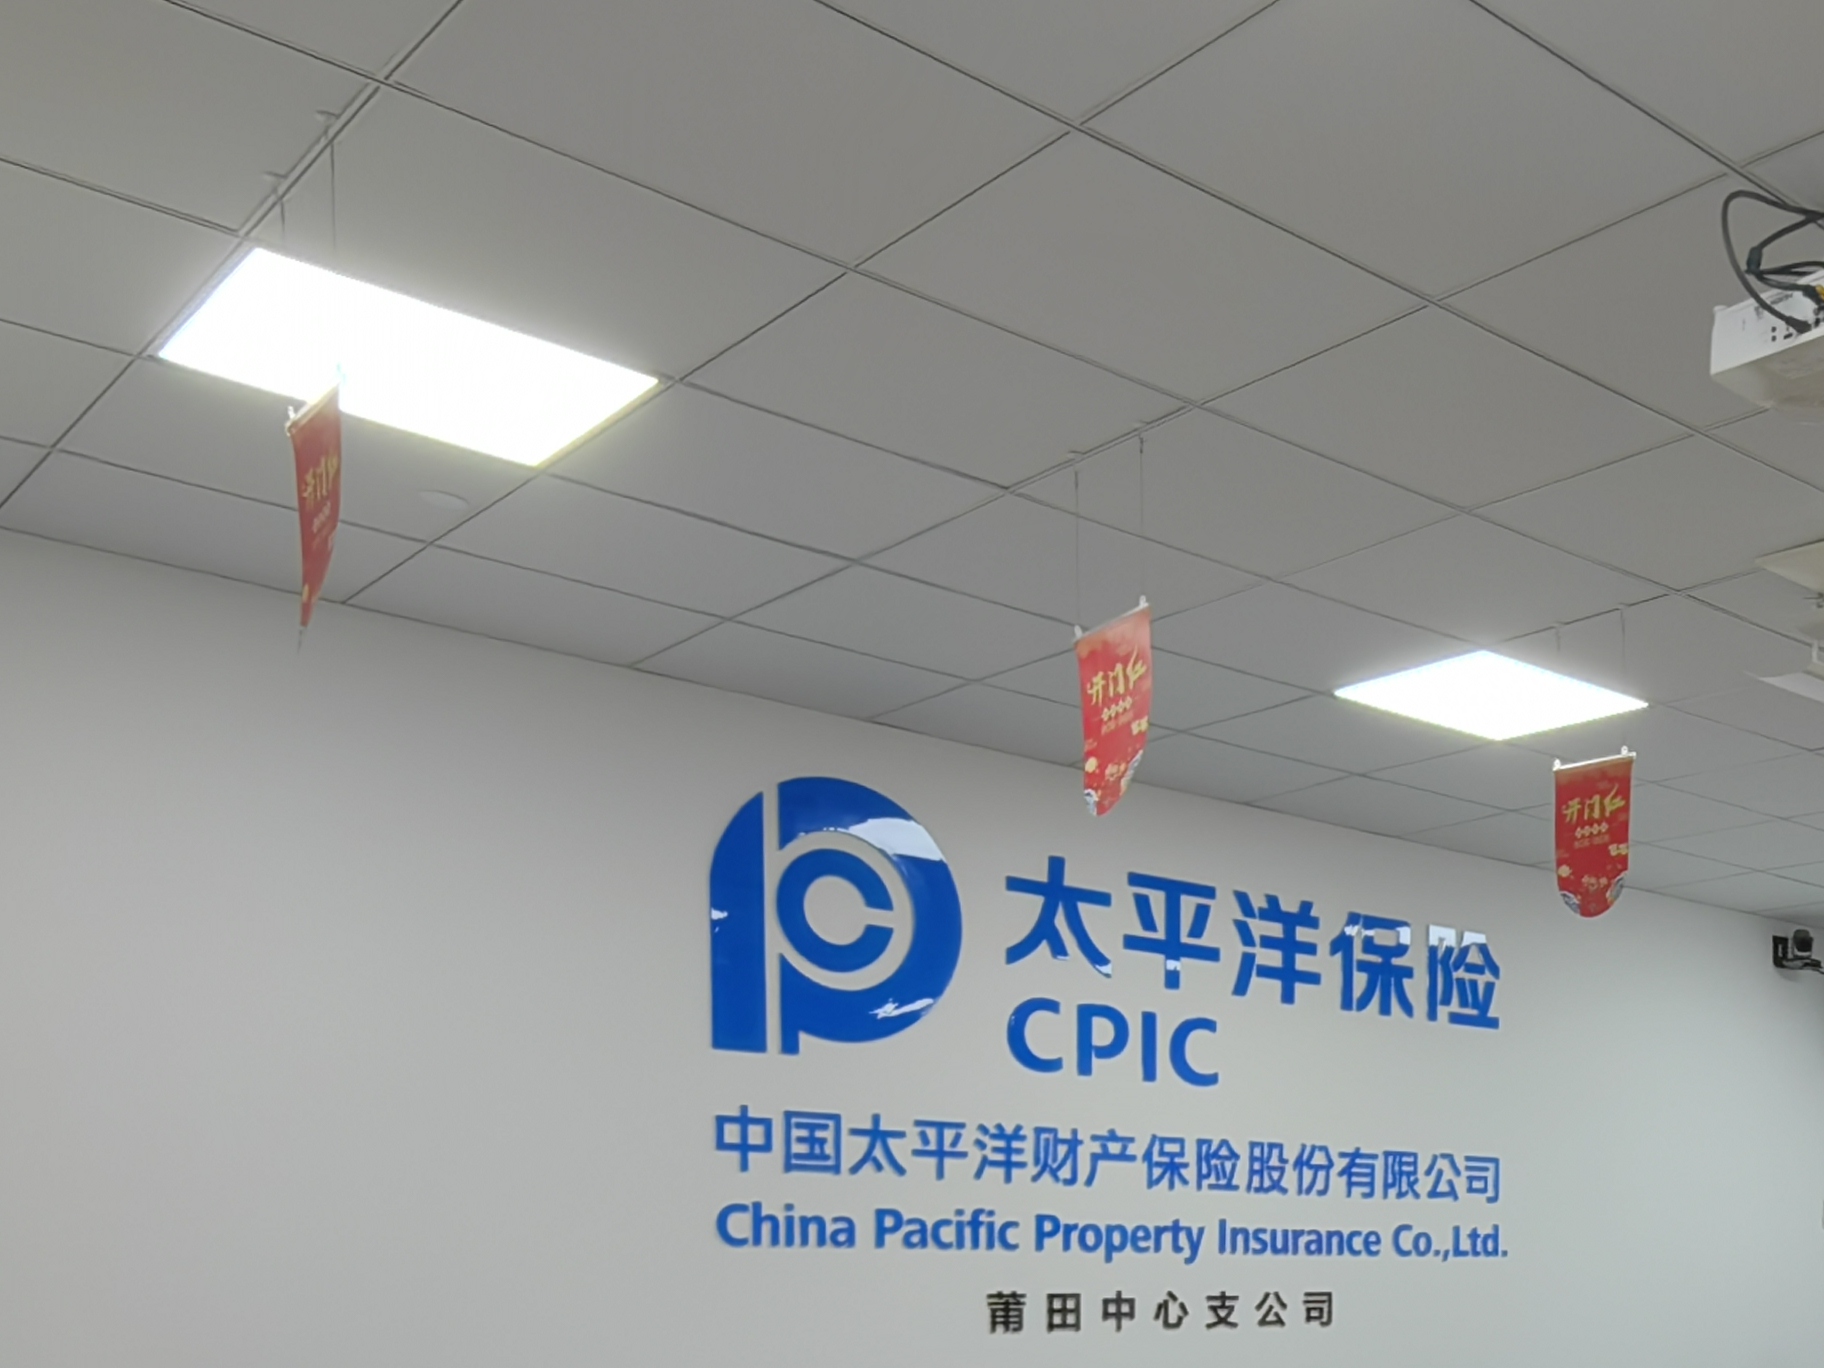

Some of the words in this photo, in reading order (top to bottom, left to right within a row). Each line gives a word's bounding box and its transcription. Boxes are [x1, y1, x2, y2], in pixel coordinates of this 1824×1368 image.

[1006, 856, 1501, 1029] 太平洋保险
[1006, 998, 1220, 1087] CPIC
[715, 1105, 1501, 1203] 中国太平洋财产保险股份有限公司
[716, 1202, 857, 1249] China
[875, 1208, 1019, 1252] Pacific
[1035, 1213, 1205, 1264] Property
[1218, 1219, 1382, 1258] Insurance
[987, 1291, 1334, 1332] 莆田中心支公司
